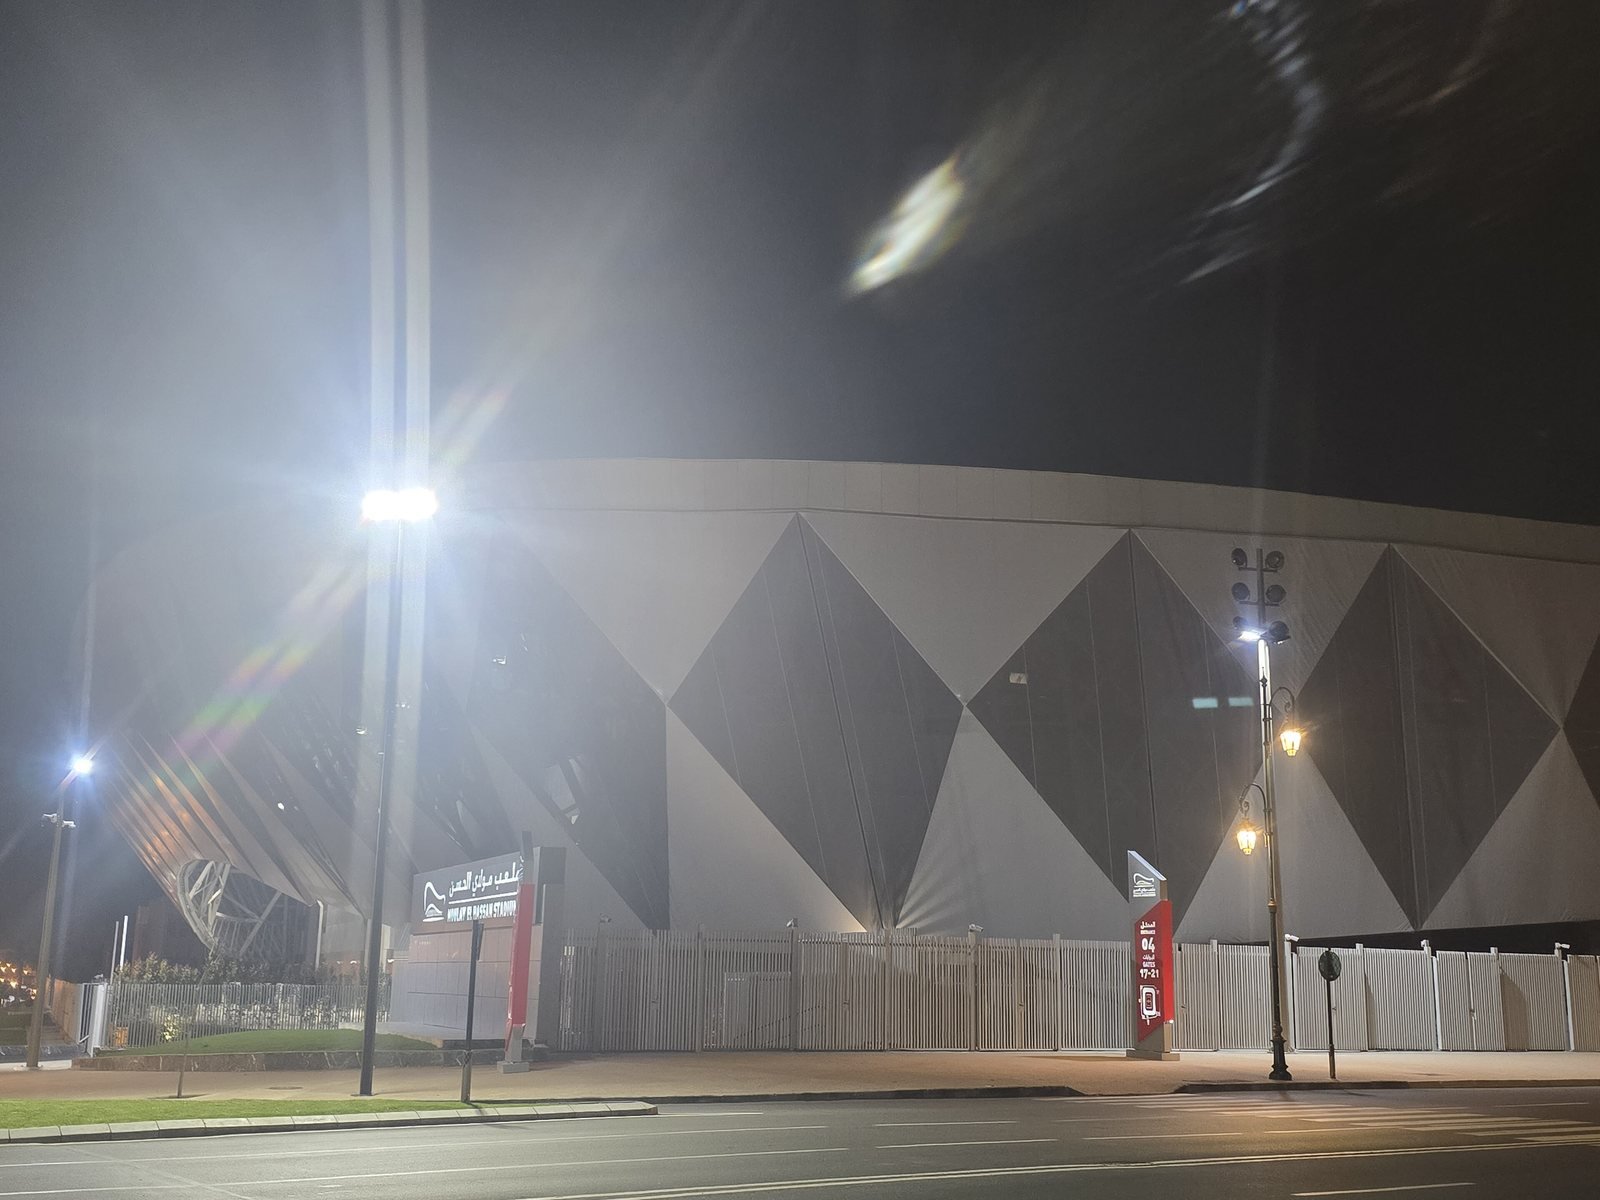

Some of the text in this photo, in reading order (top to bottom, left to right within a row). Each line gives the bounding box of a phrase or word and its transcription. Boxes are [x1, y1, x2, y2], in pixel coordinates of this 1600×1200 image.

[449, 871, 472, 898] الحسن
[1142, 937, 1155, 953] 04
[1140, 968, 1159, 979] 17-21
